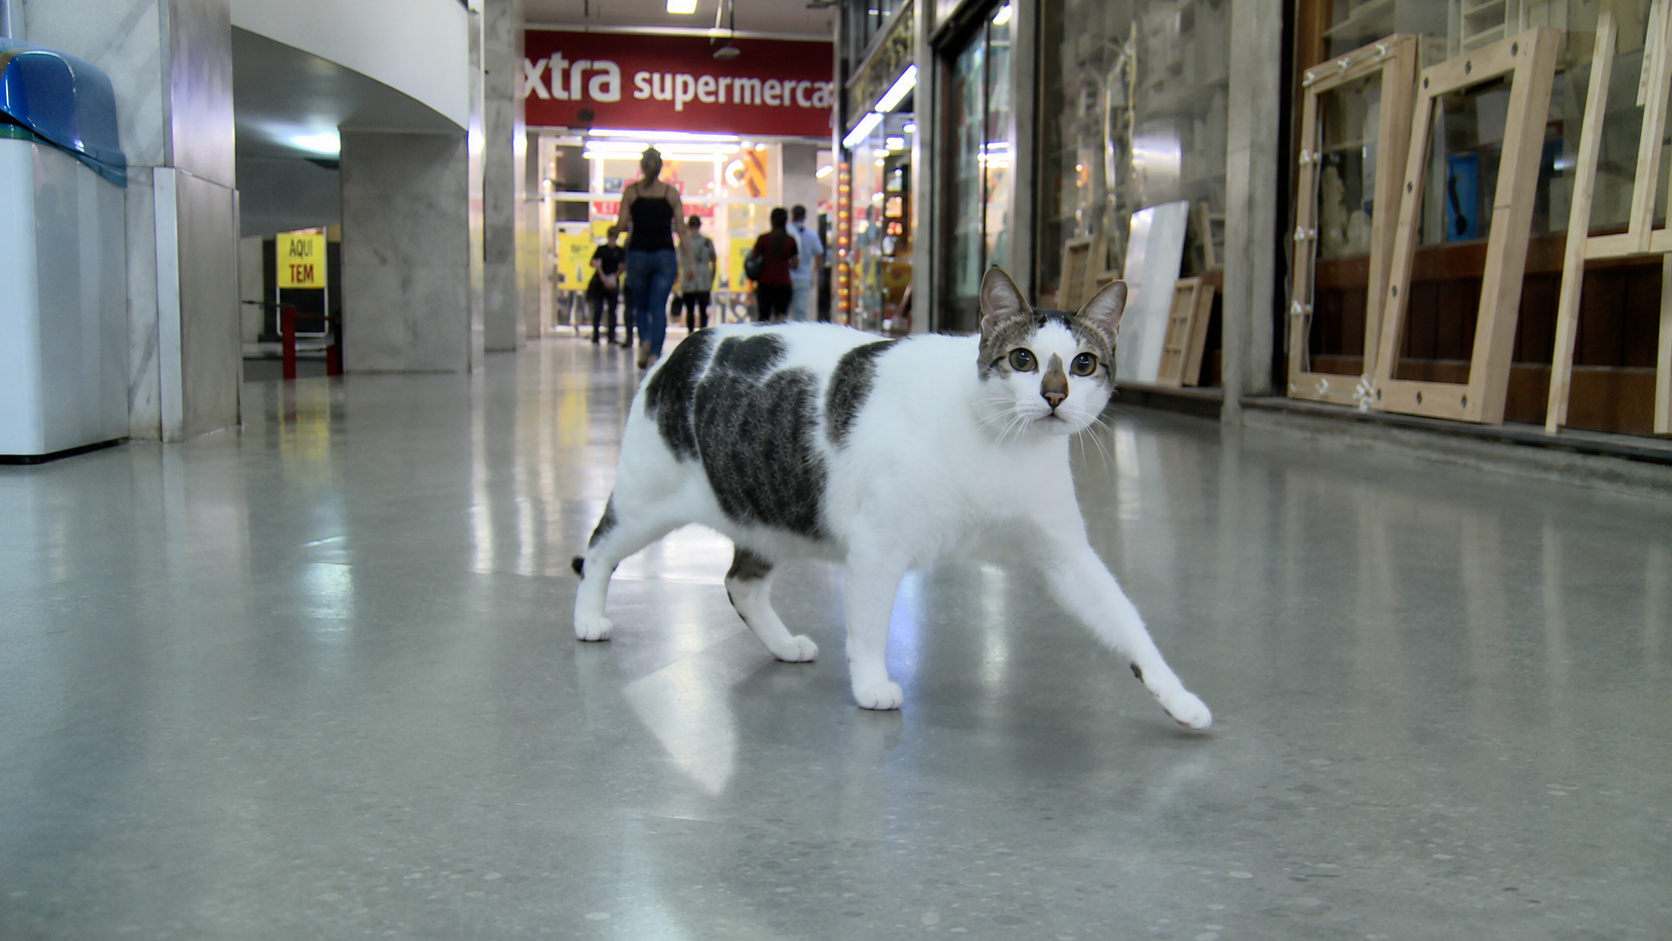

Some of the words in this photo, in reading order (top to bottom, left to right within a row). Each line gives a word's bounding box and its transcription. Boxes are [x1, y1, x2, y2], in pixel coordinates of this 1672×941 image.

[525, 51, 621, 103] xtra
[289, 238, 313, 258] AQUI
[289, 264, 314, 283] TEM
